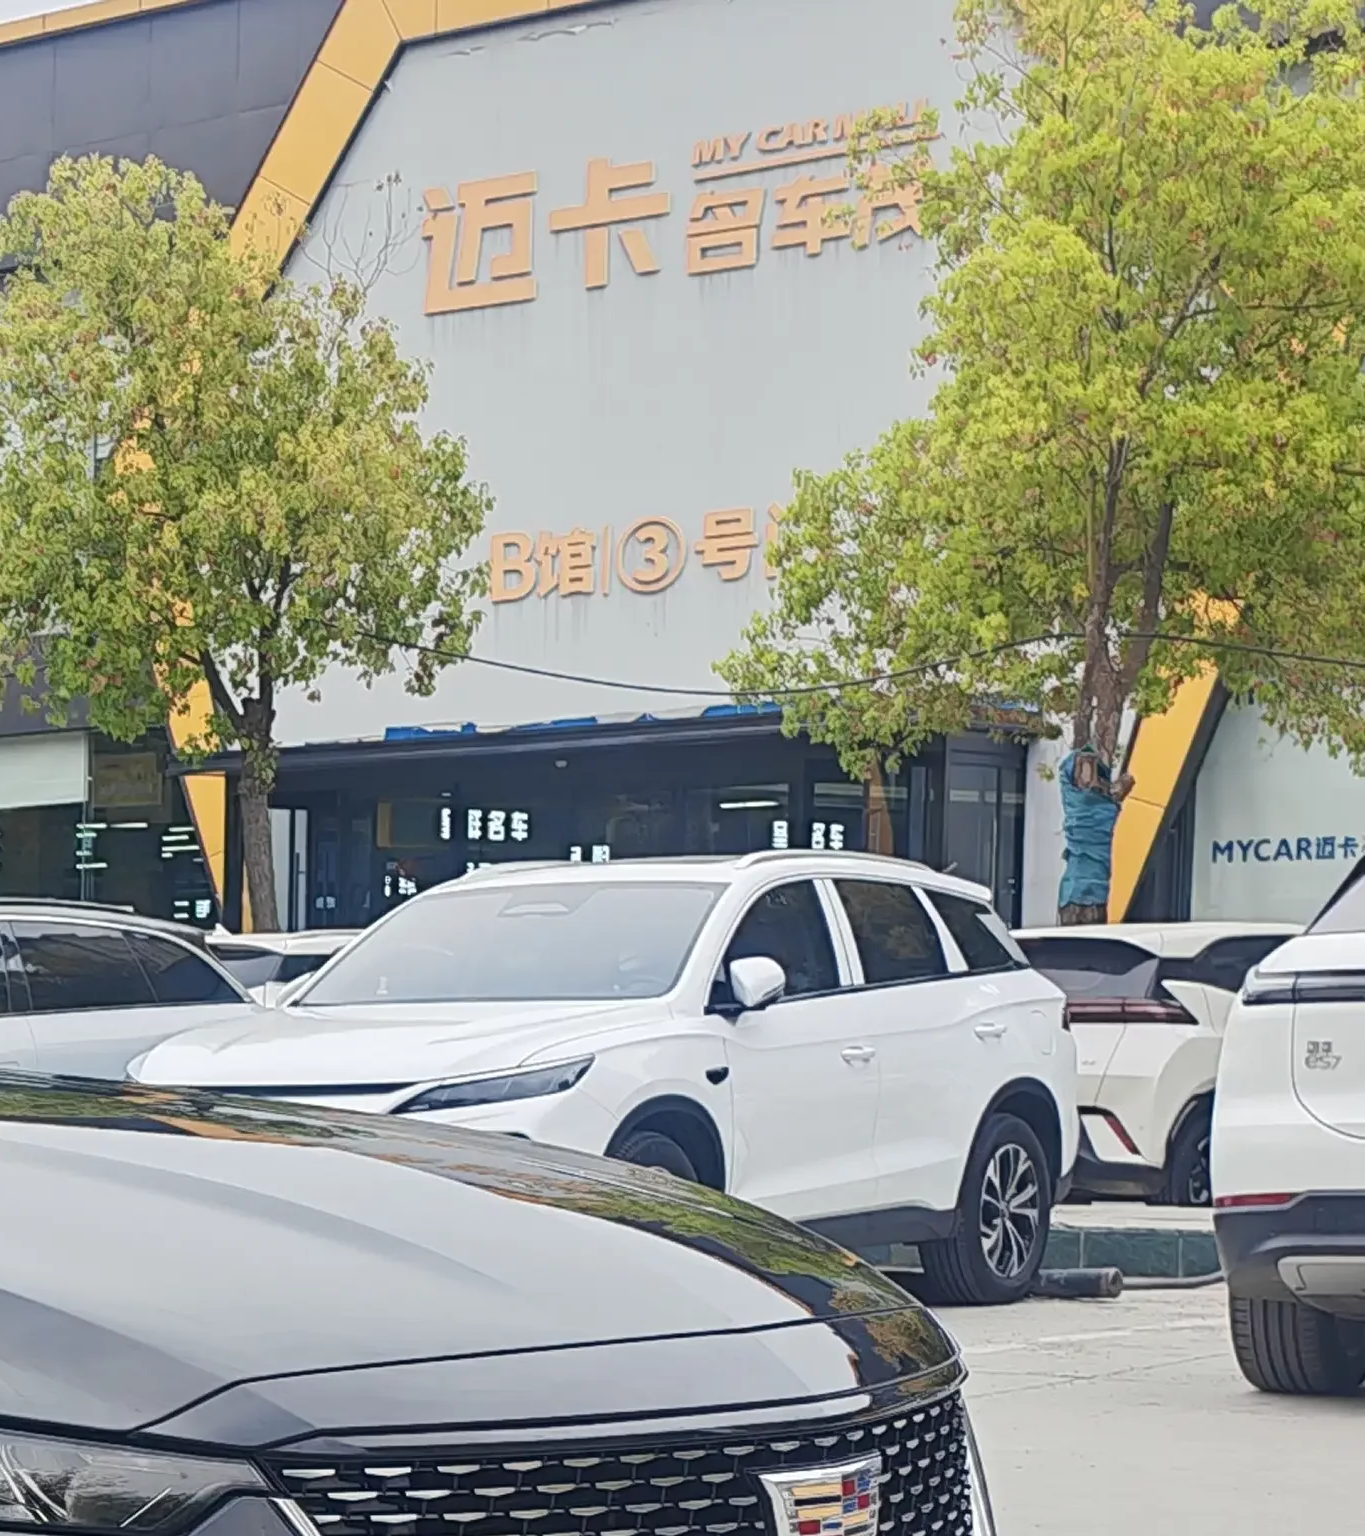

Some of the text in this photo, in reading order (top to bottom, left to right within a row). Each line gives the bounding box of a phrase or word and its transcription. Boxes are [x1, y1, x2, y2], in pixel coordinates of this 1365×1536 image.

[692, 131, 750, 167] MY
[757, 118, 829, 153] CAR
[421, 158, 671, 317] 迈卡
